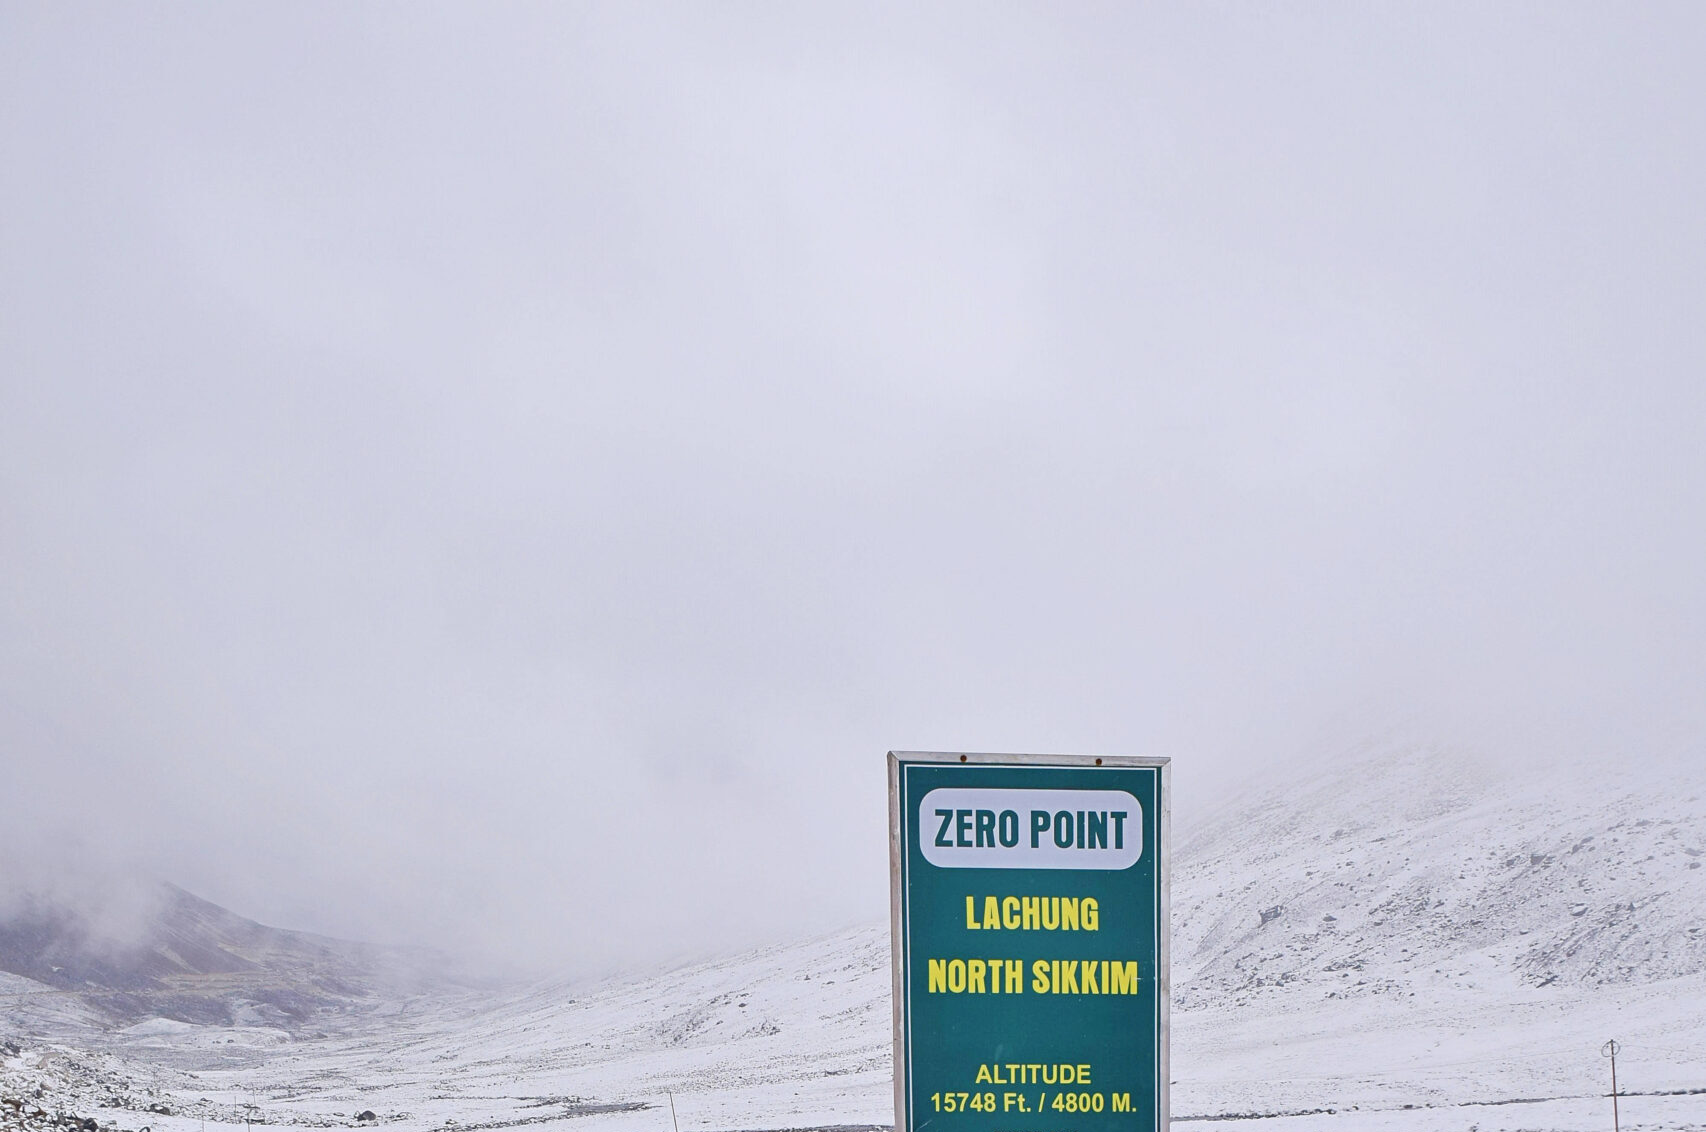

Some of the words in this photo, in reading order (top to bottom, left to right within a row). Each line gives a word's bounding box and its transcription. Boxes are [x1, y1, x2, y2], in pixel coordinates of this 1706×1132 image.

[934, 808, 1020, 849] ZERO
[1030, 809, 1128, 850] POINT
[965, 895, 1099, 932] LACHUNG
[928, 958, 1023, 994] NORTH
[1032, 959, 1138, 995] SIKKIM
[975, 1063, 1092, 1085] ALTITUDE
[931, 1092, 997, 1113] 15748
[1003, 1092, 1032, 1113] Ft.
[1038, 1092, 1046, 1113] /
[1051, 1092, 1105, 1113] 4800
[1112, 1092, 1137, 1113] M.
